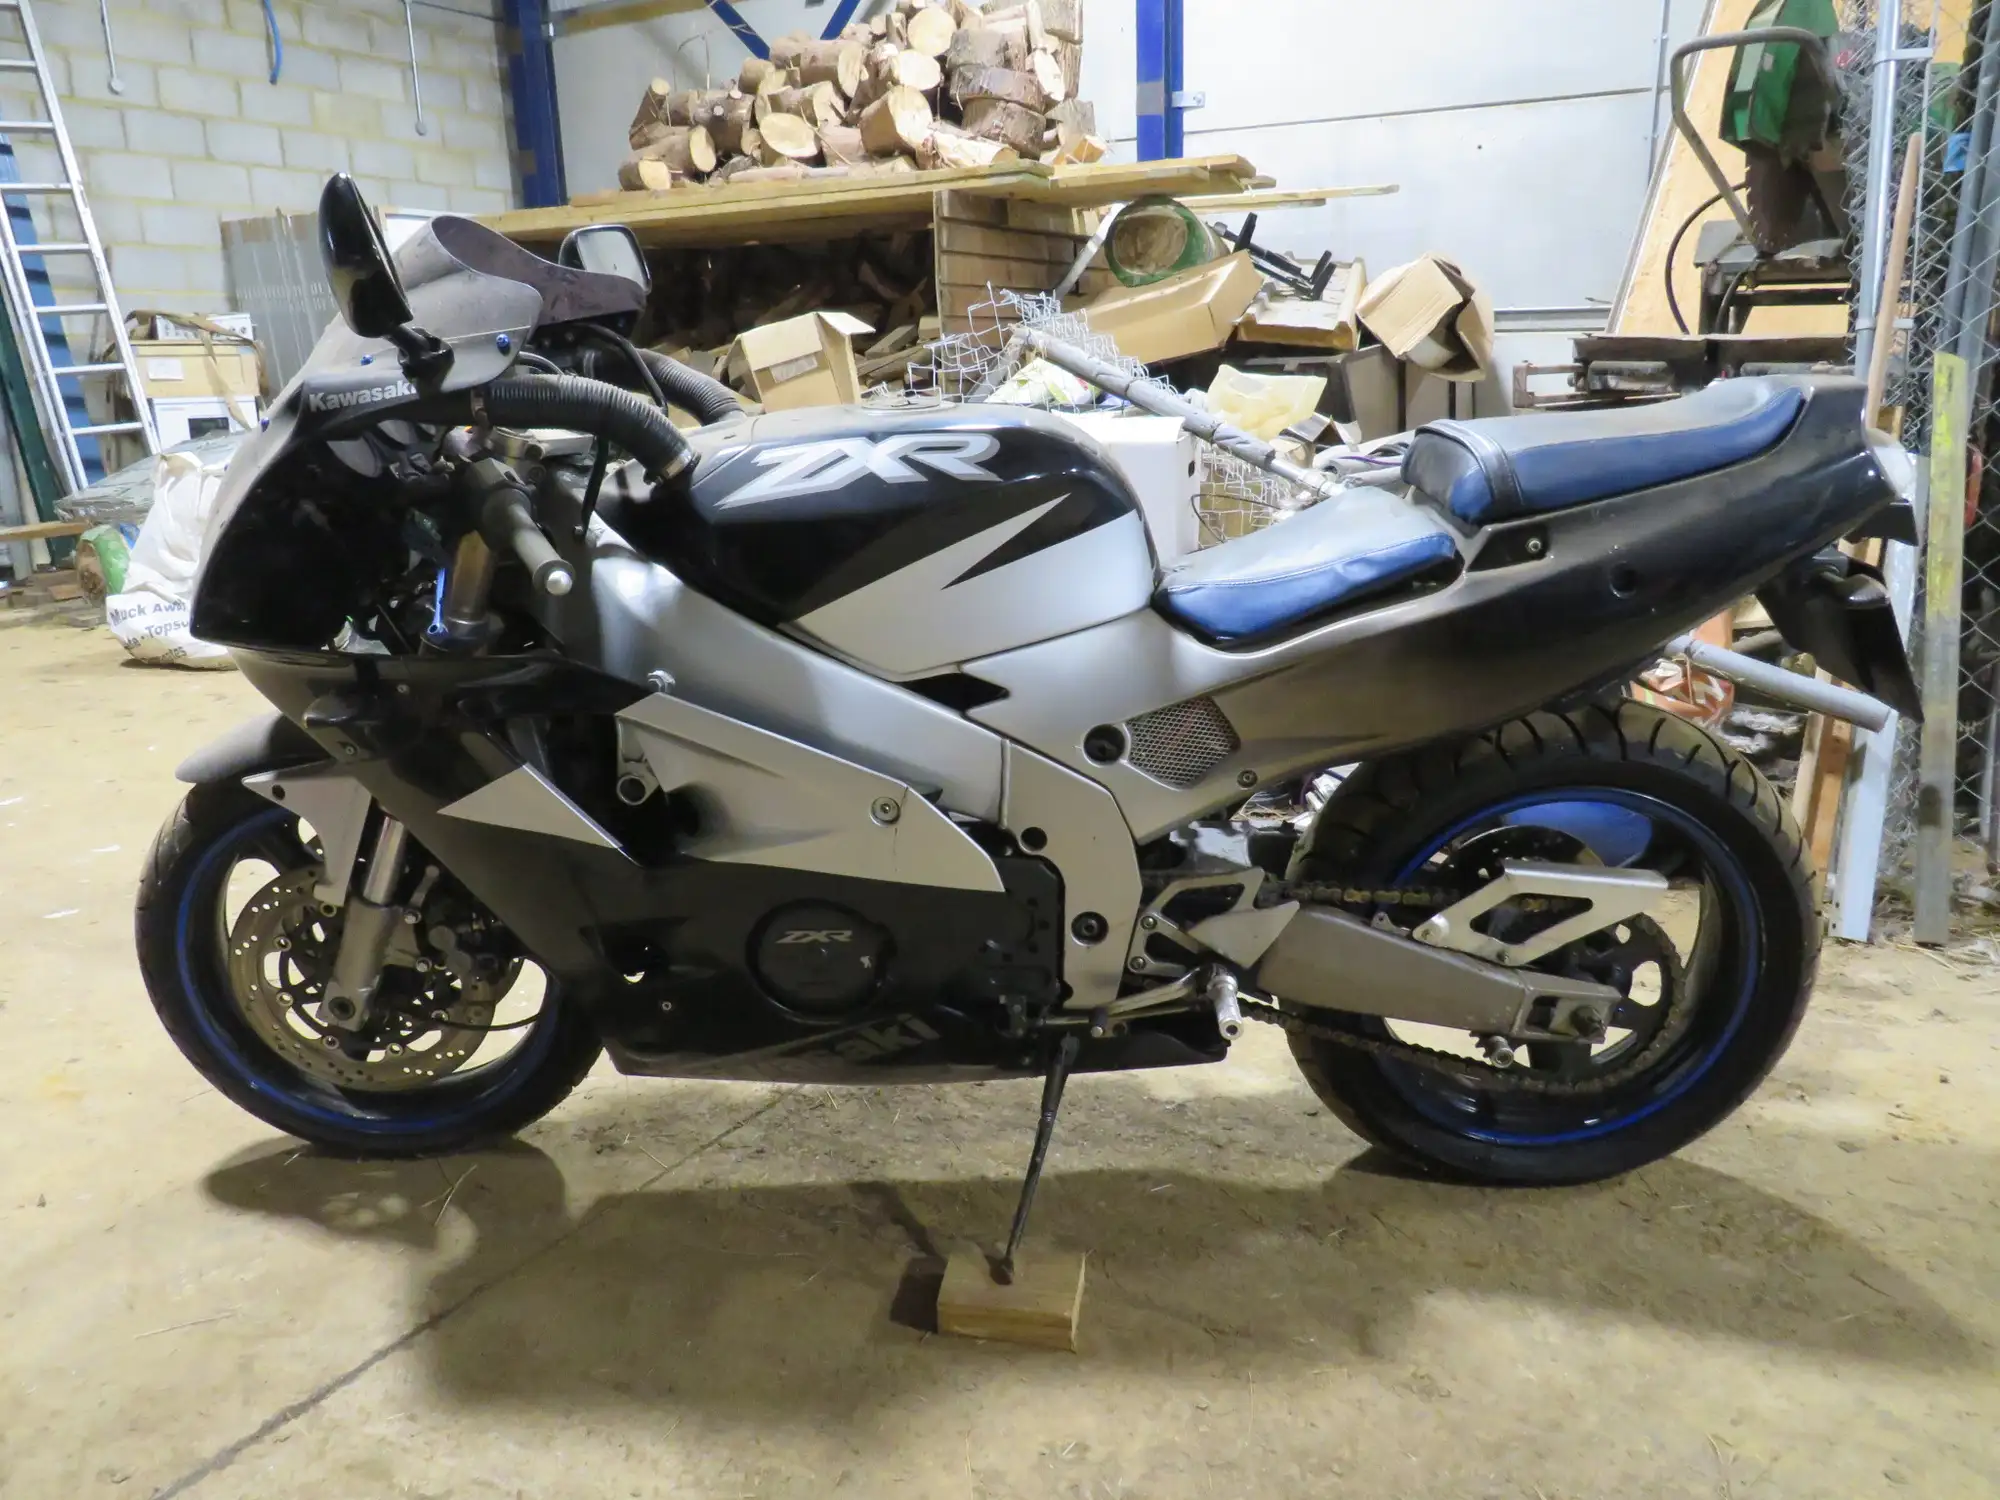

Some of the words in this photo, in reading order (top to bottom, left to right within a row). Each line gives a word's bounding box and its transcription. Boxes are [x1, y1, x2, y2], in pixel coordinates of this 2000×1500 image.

[713, 433, 1003, 510] ZXR
[109, 604, 147, 627] Muck
[775, 930, 853, 944] ZXR
